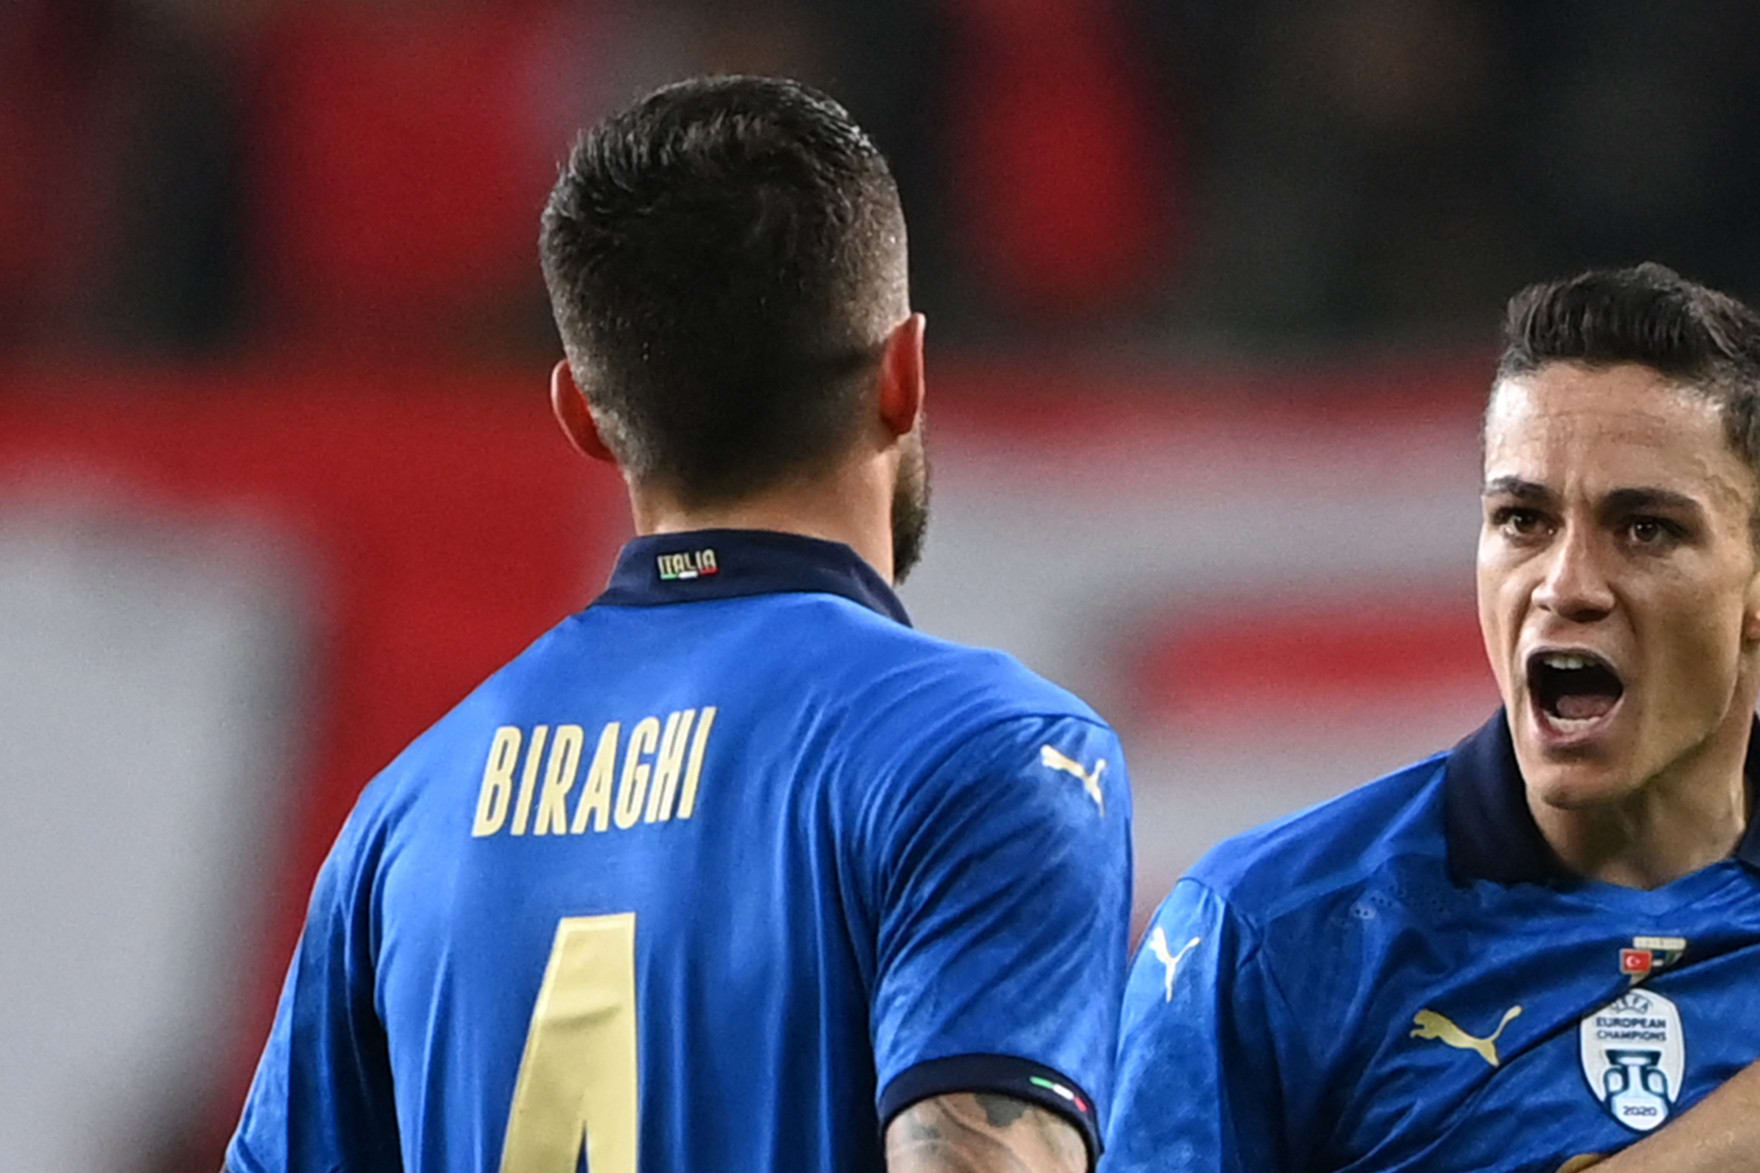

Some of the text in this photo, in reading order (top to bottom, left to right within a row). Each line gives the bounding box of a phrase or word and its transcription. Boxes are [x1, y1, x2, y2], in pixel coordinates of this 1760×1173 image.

[657, 548, 718, 577] ITALIA
[471, 706, 718, 837] BIRAGHI
[1596, 1017, 1667, 1029] EUROPEAN
[1623, 1105, 1658, 1116] 2020
